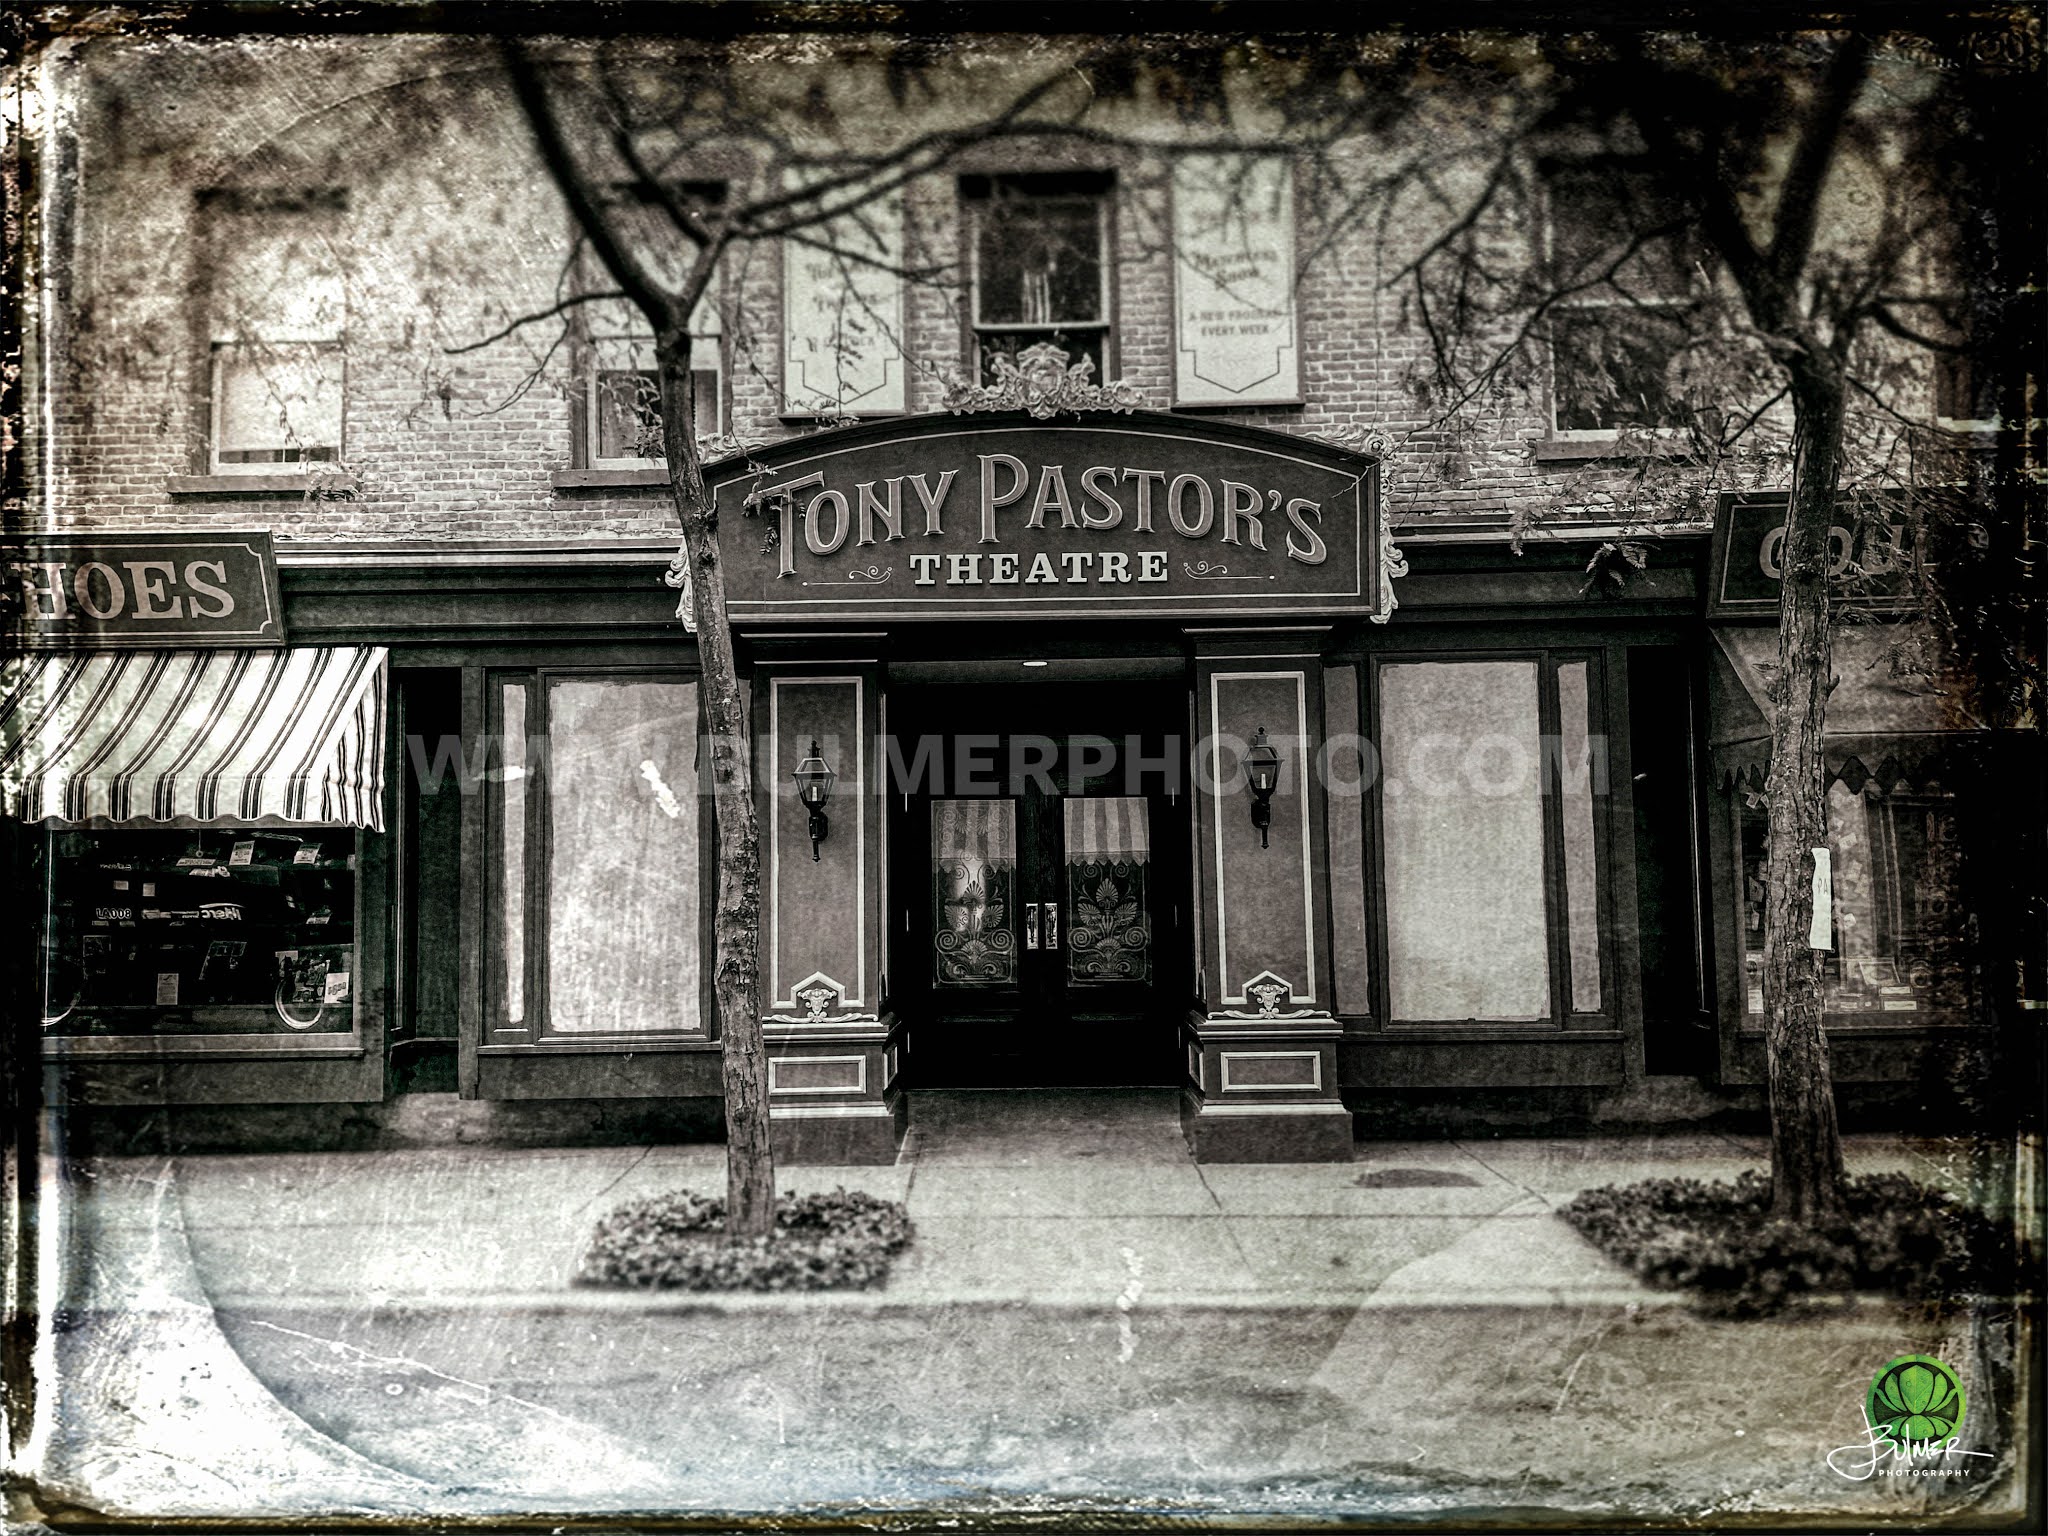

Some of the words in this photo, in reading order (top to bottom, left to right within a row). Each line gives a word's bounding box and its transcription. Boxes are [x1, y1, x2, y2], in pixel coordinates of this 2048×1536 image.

[1201, 326, 1235, 337] EVERY
[1239, 324, 1269, 336] WEEK
[750, 469, 959, 579] TONY
[977, 453, 1327, 565] PASTOR'S
[0, 560, 235, 620] HOES
[909, 551, 1169, 585] THEATRE
